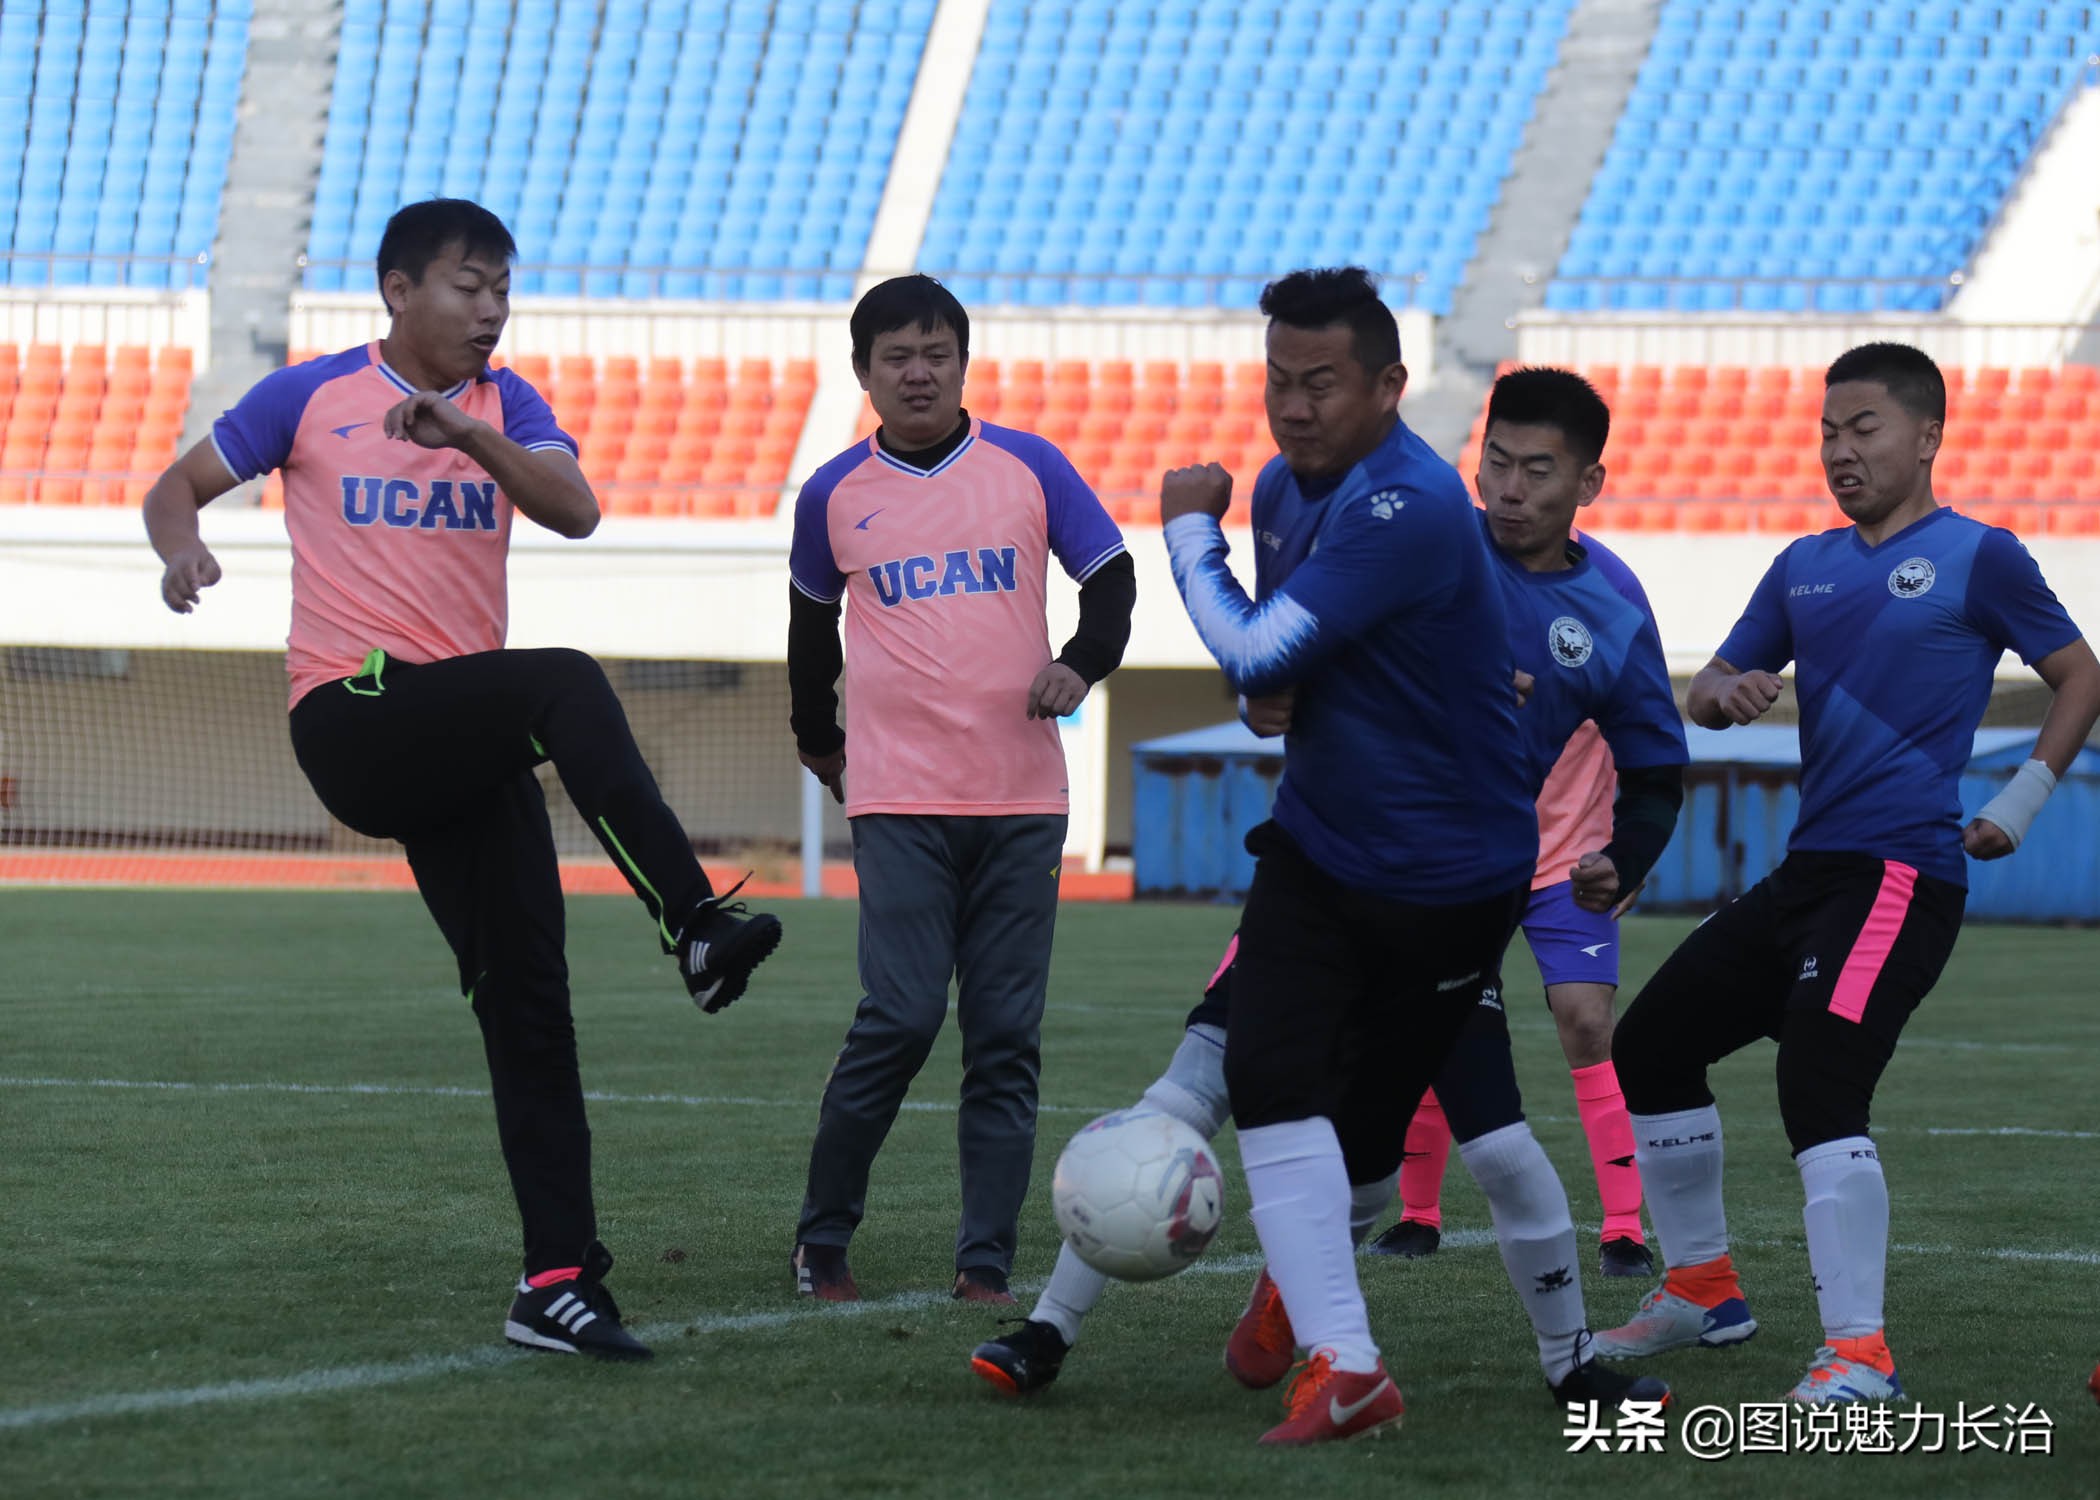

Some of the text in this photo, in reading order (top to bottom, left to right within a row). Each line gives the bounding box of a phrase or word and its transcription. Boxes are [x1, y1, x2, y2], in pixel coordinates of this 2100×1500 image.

[339, 474, 498, 531] UCAN
[867, 546, 1017, 609] UCAN
[1789, 583, 1836, 598] KELME
[1648, 1131, 1715, 1148] KELME
